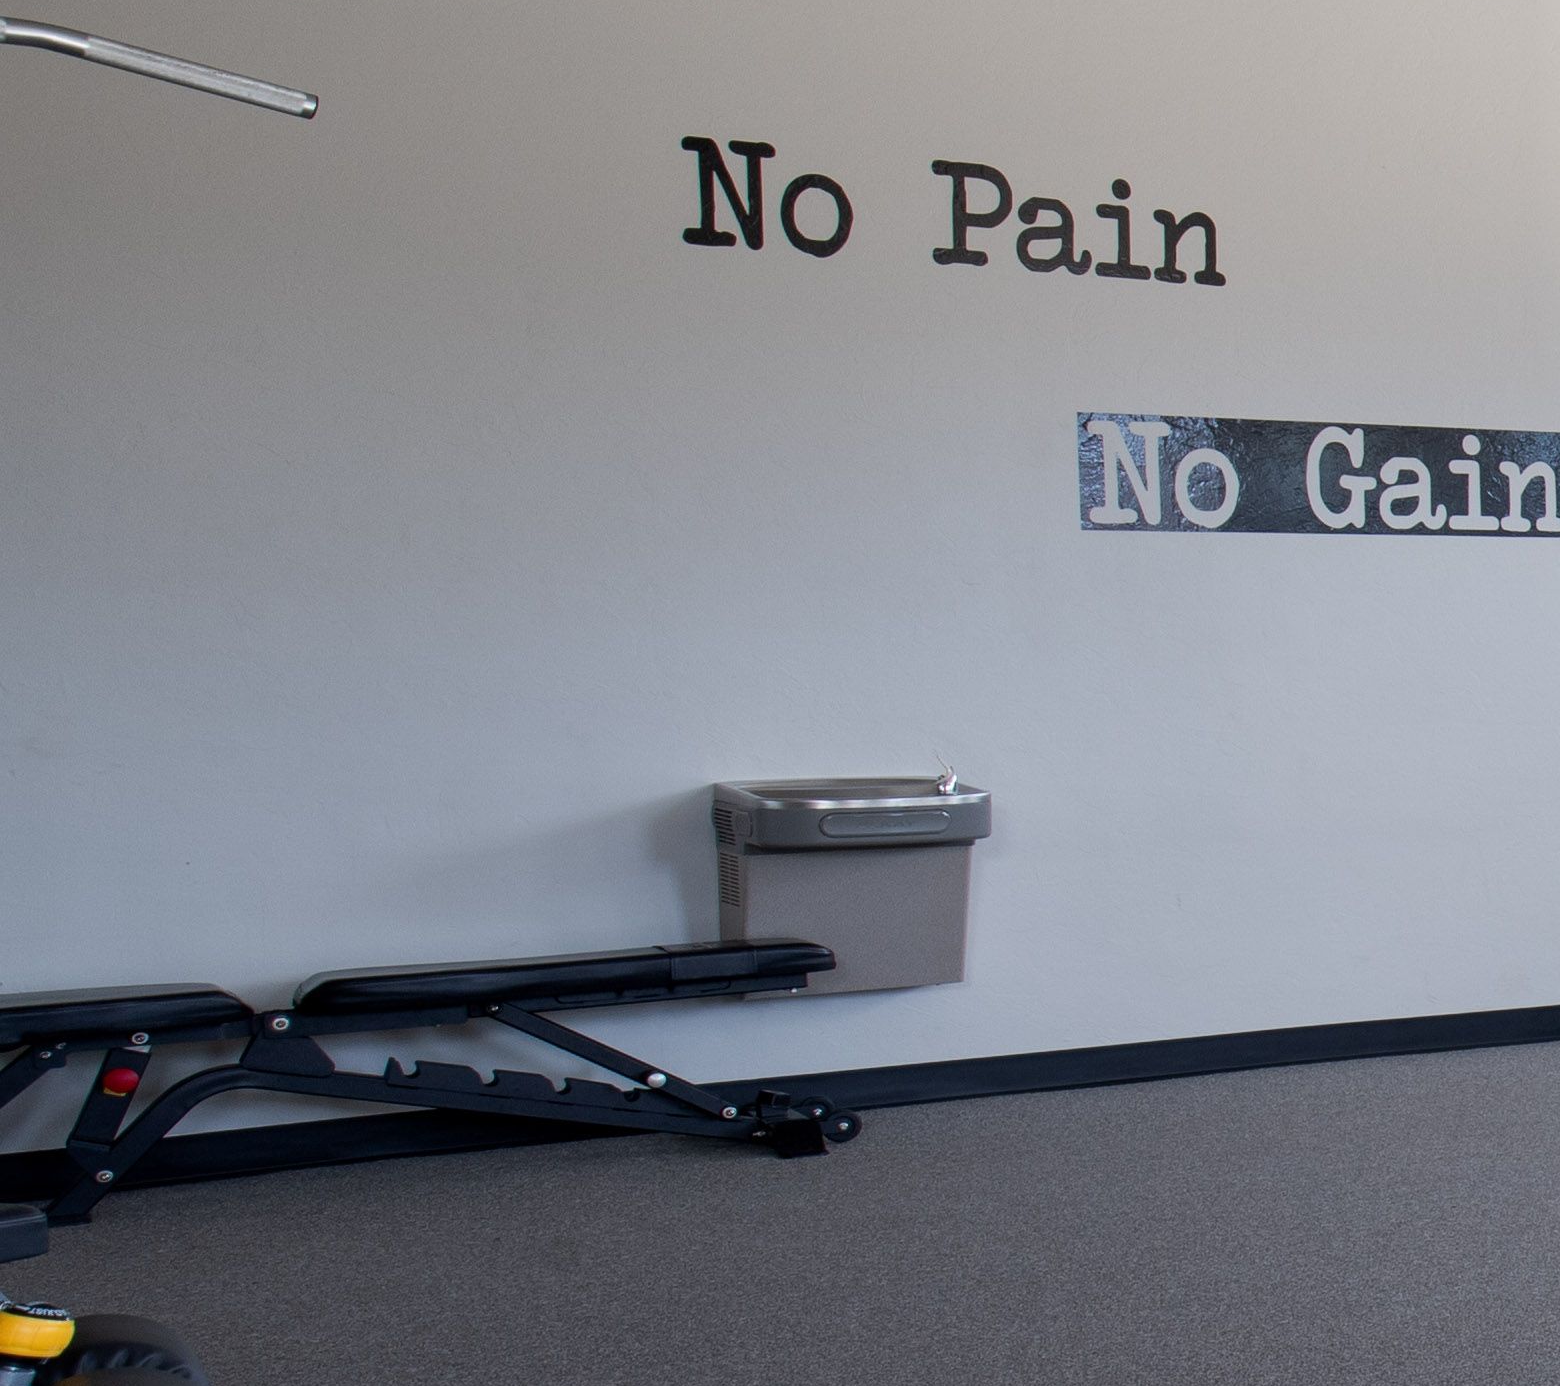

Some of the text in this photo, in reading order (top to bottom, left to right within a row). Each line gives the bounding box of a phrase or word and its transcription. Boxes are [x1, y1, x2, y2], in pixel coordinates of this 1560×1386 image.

[681, 136, 1227, 287] No Pain
[1085, 420, 1241, 530] No
